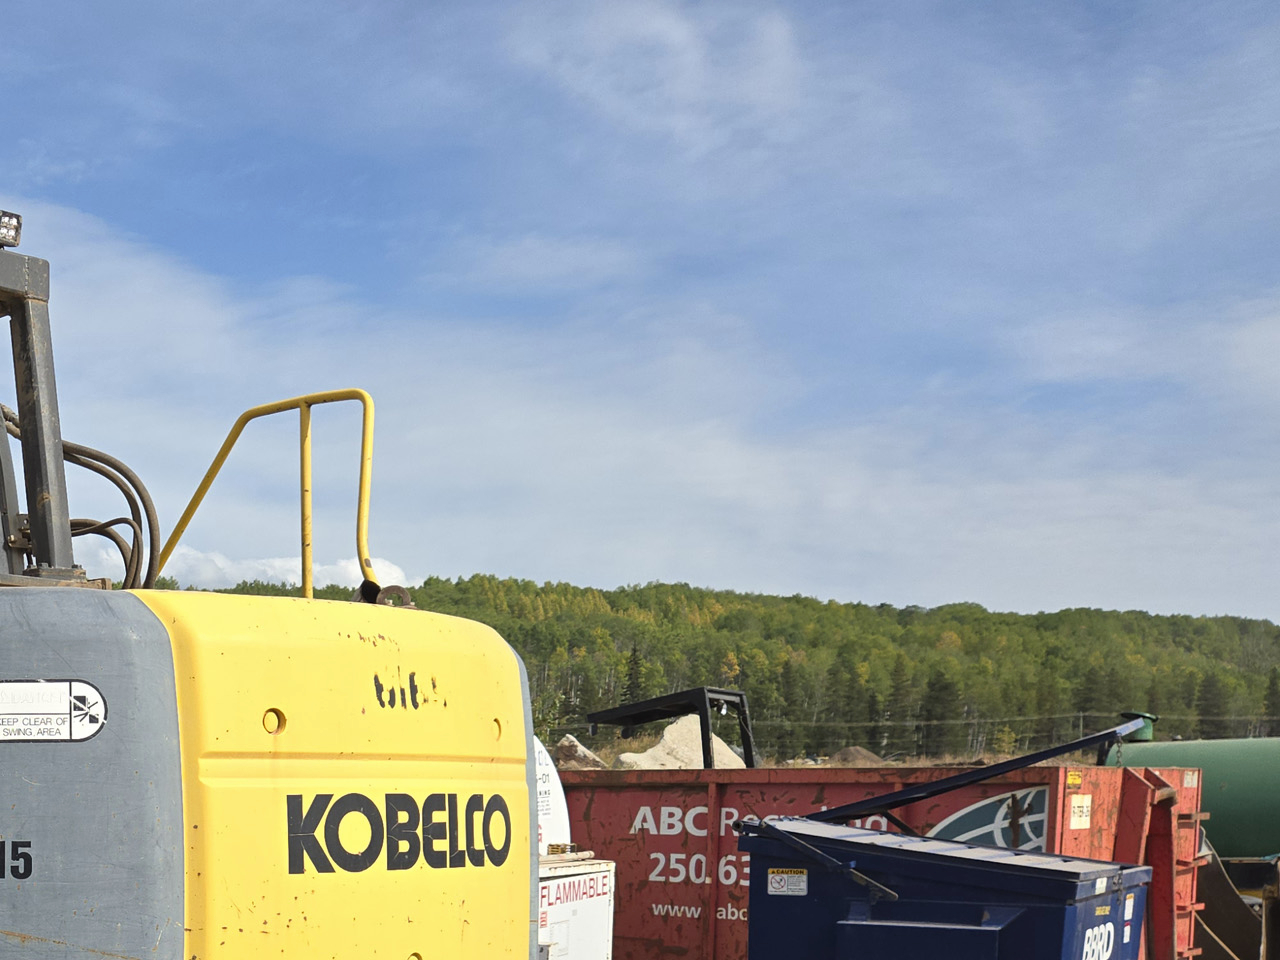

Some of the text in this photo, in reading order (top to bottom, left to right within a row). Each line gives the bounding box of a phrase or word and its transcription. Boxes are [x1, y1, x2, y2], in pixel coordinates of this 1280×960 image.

[22, 718, 53, 727] CLEAR
[56, 718, 69, 727] OF
[38, 728, 61, 737] AREA
[286, 793, 511, 874] KOBELCO
[629, 806, 709, 837] ABC
[540, 875, 609, 909] FLAMMABLE
